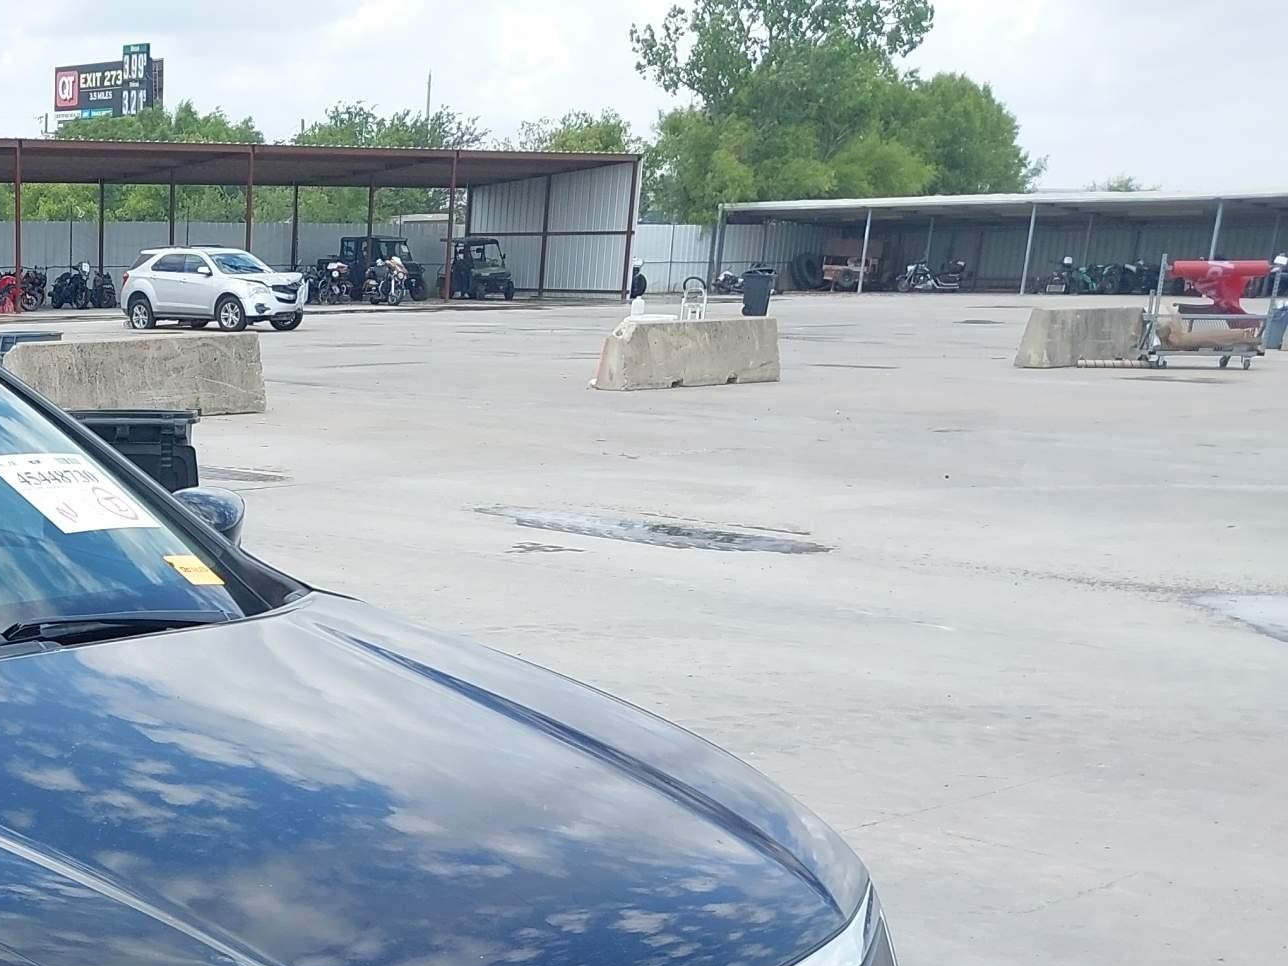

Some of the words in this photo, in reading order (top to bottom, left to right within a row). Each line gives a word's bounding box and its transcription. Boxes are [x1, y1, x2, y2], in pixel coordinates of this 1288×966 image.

[79, 72, 102, 88] EXIT
[104, 70, 122, 86] 273
[59, 76, 74, 101] QT
[97, 91, 113, 100] MILES
